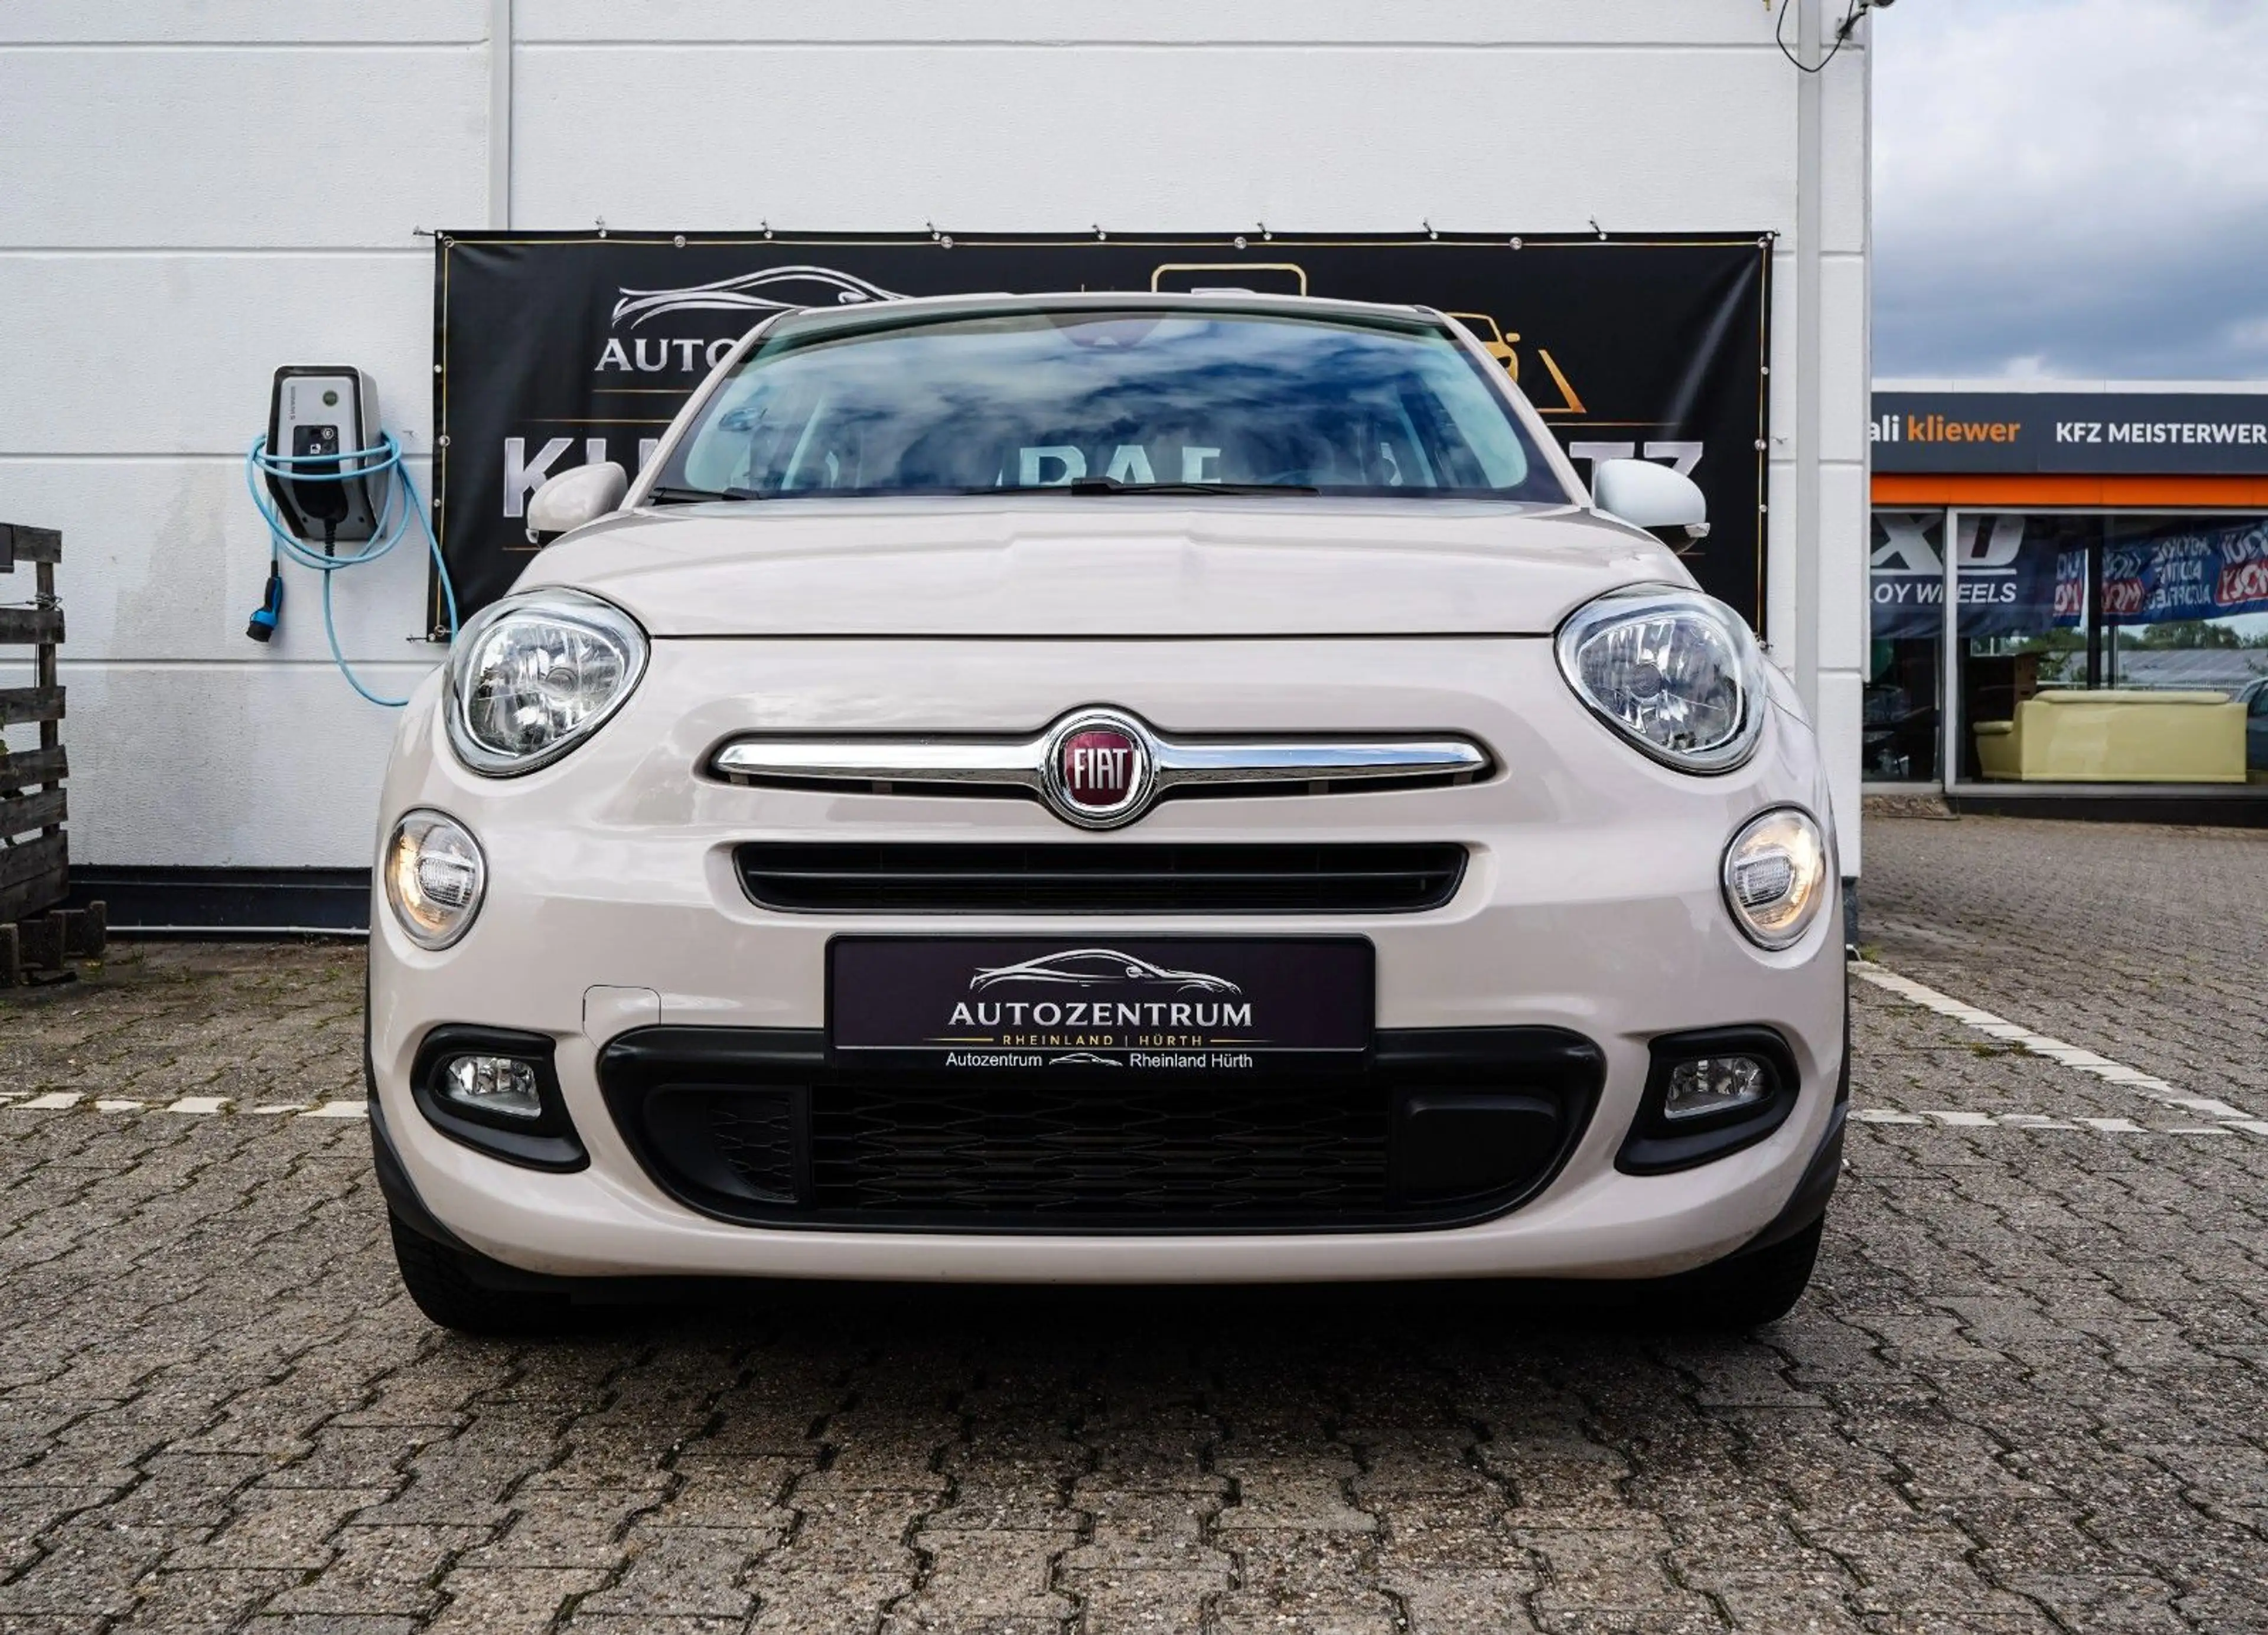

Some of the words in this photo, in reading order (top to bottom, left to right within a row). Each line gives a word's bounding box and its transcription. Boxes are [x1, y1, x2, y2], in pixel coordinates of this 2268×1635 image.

[1908, 415, 2021, 442] kliewer
[2057, 422, 2101, 443] KFZ
[2109, 422, 2267, 444] MEISTERWER
[1074, 748, 1128, 789] FIAT
[947, 1002, 1253, 1026] AUTOZENTRUM
[1003, 1035, 1113, 1046] RHEINLAND
[1139, 1034, 1203, 1046] HÜRTH
[946, 1052, 1042, 1066] Autozentrum
[1130, 1053, 1206, 1068] Rheinland
[1212, 1053, 1253, 1068] Hürth
